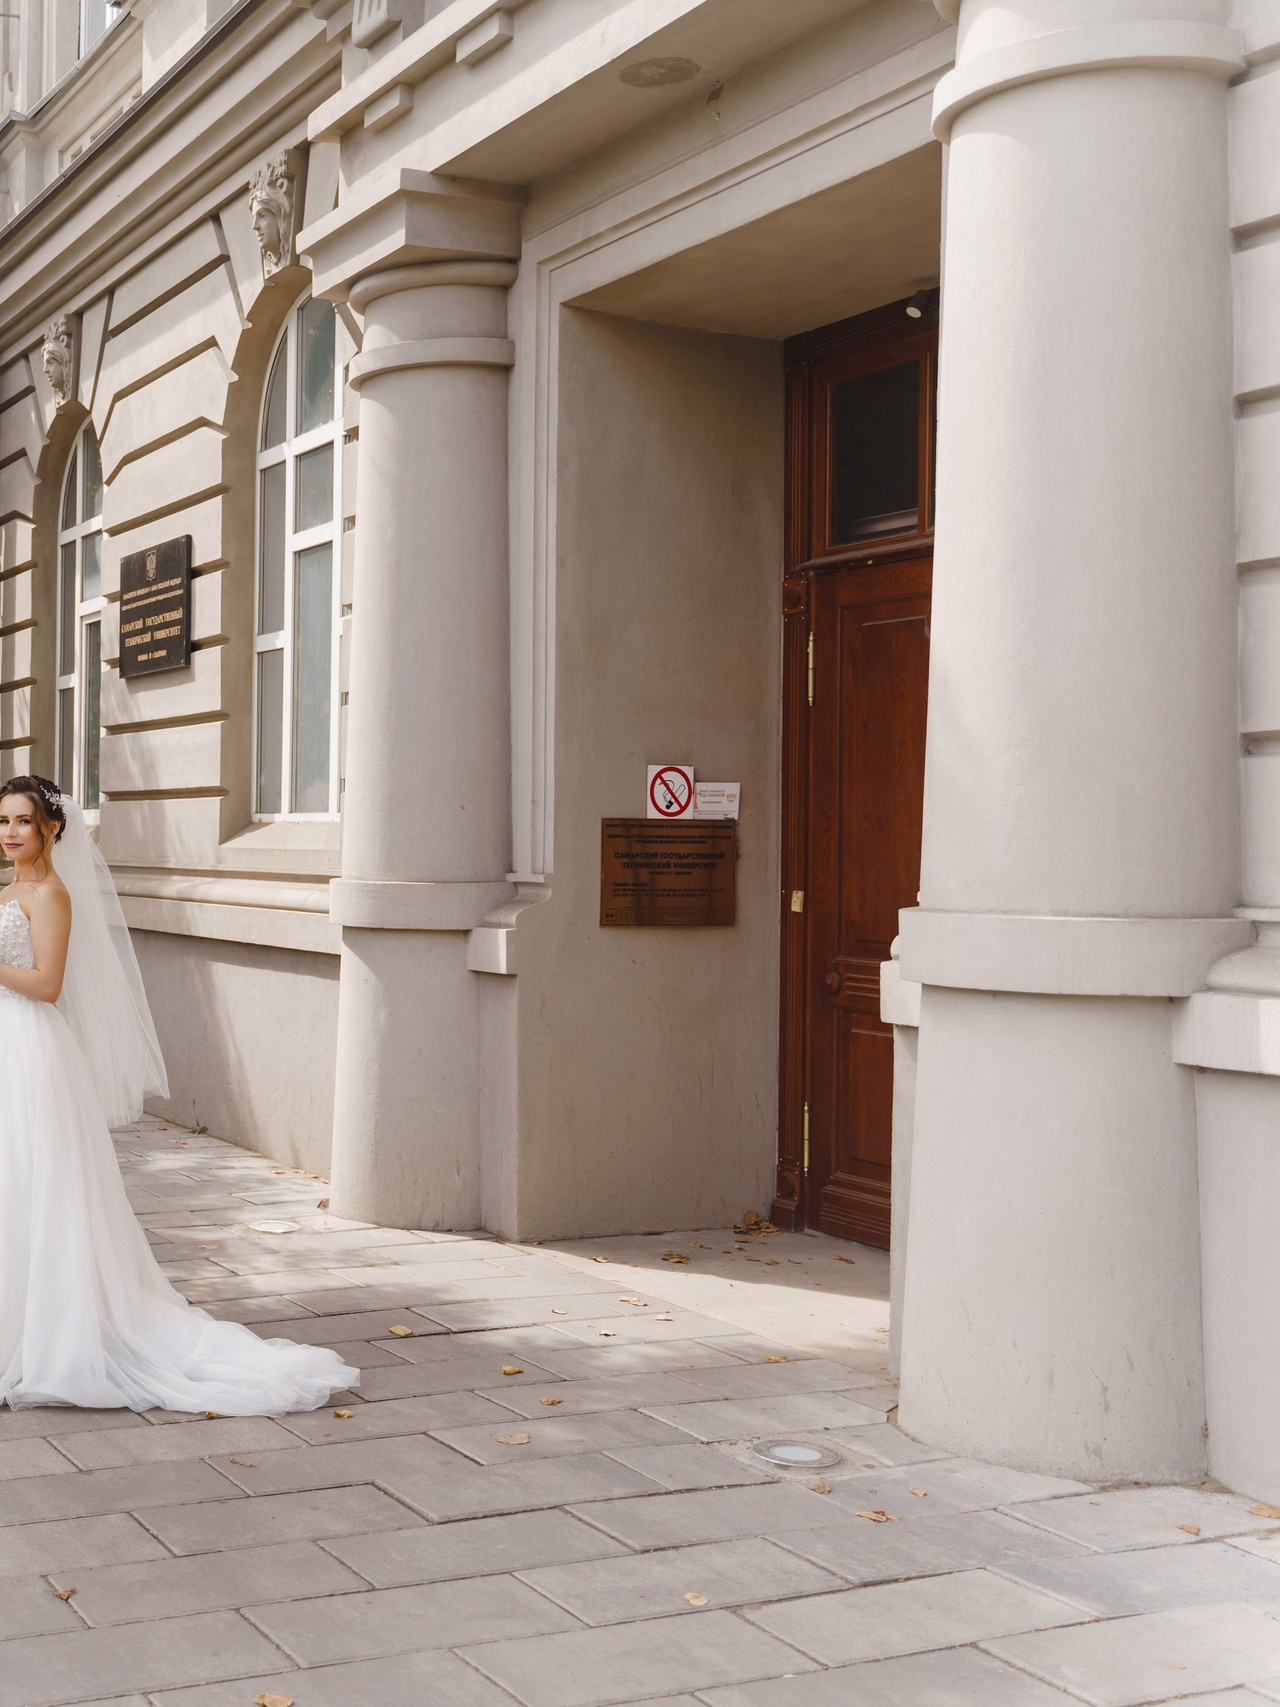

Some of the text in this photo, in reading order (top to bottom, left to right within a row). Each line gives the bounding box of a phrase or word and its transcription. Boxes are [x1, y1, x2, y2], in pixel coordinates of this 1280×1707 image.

[614, 851, 725, 860] САМАРСКИЙ ГОСУДАРСТВЕННЫЙ
[623, 861, 671, 869] ТЕХНИЧЕСКИЙ
